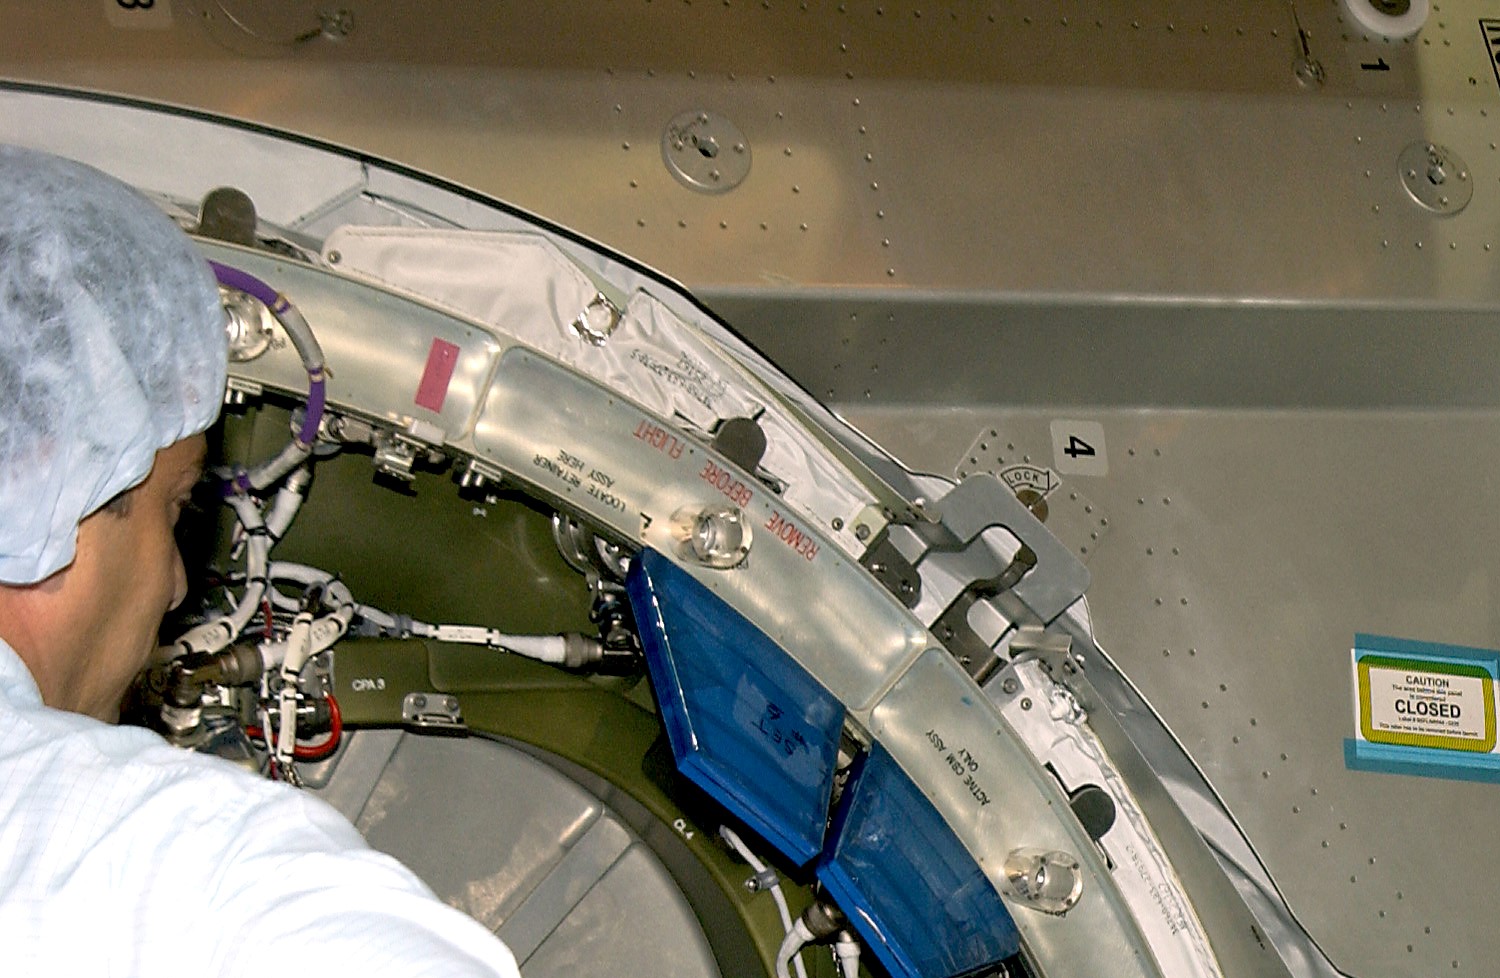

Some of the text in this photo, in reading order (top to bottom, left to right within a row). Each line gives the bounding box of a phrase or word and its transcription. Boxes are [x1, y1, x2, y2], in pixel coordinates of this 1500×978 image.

[1361, 58, 1390, 71] 1
[1064, 436, 1095, 458] 4
[557, 449, 615, 488] ASSY HERE
[1007, 471, 1039, 484] LOCK
[533, 454, 626, 512] LOCATE RETAINER
[633, 420, 820, 561] REMOVE BEFORE FLIGHT
[1406, 675, 1449, 688] CAUTION
[1395, 699, 1461, 719] CLOSED
[926, 729, 946, 752] ASSY
